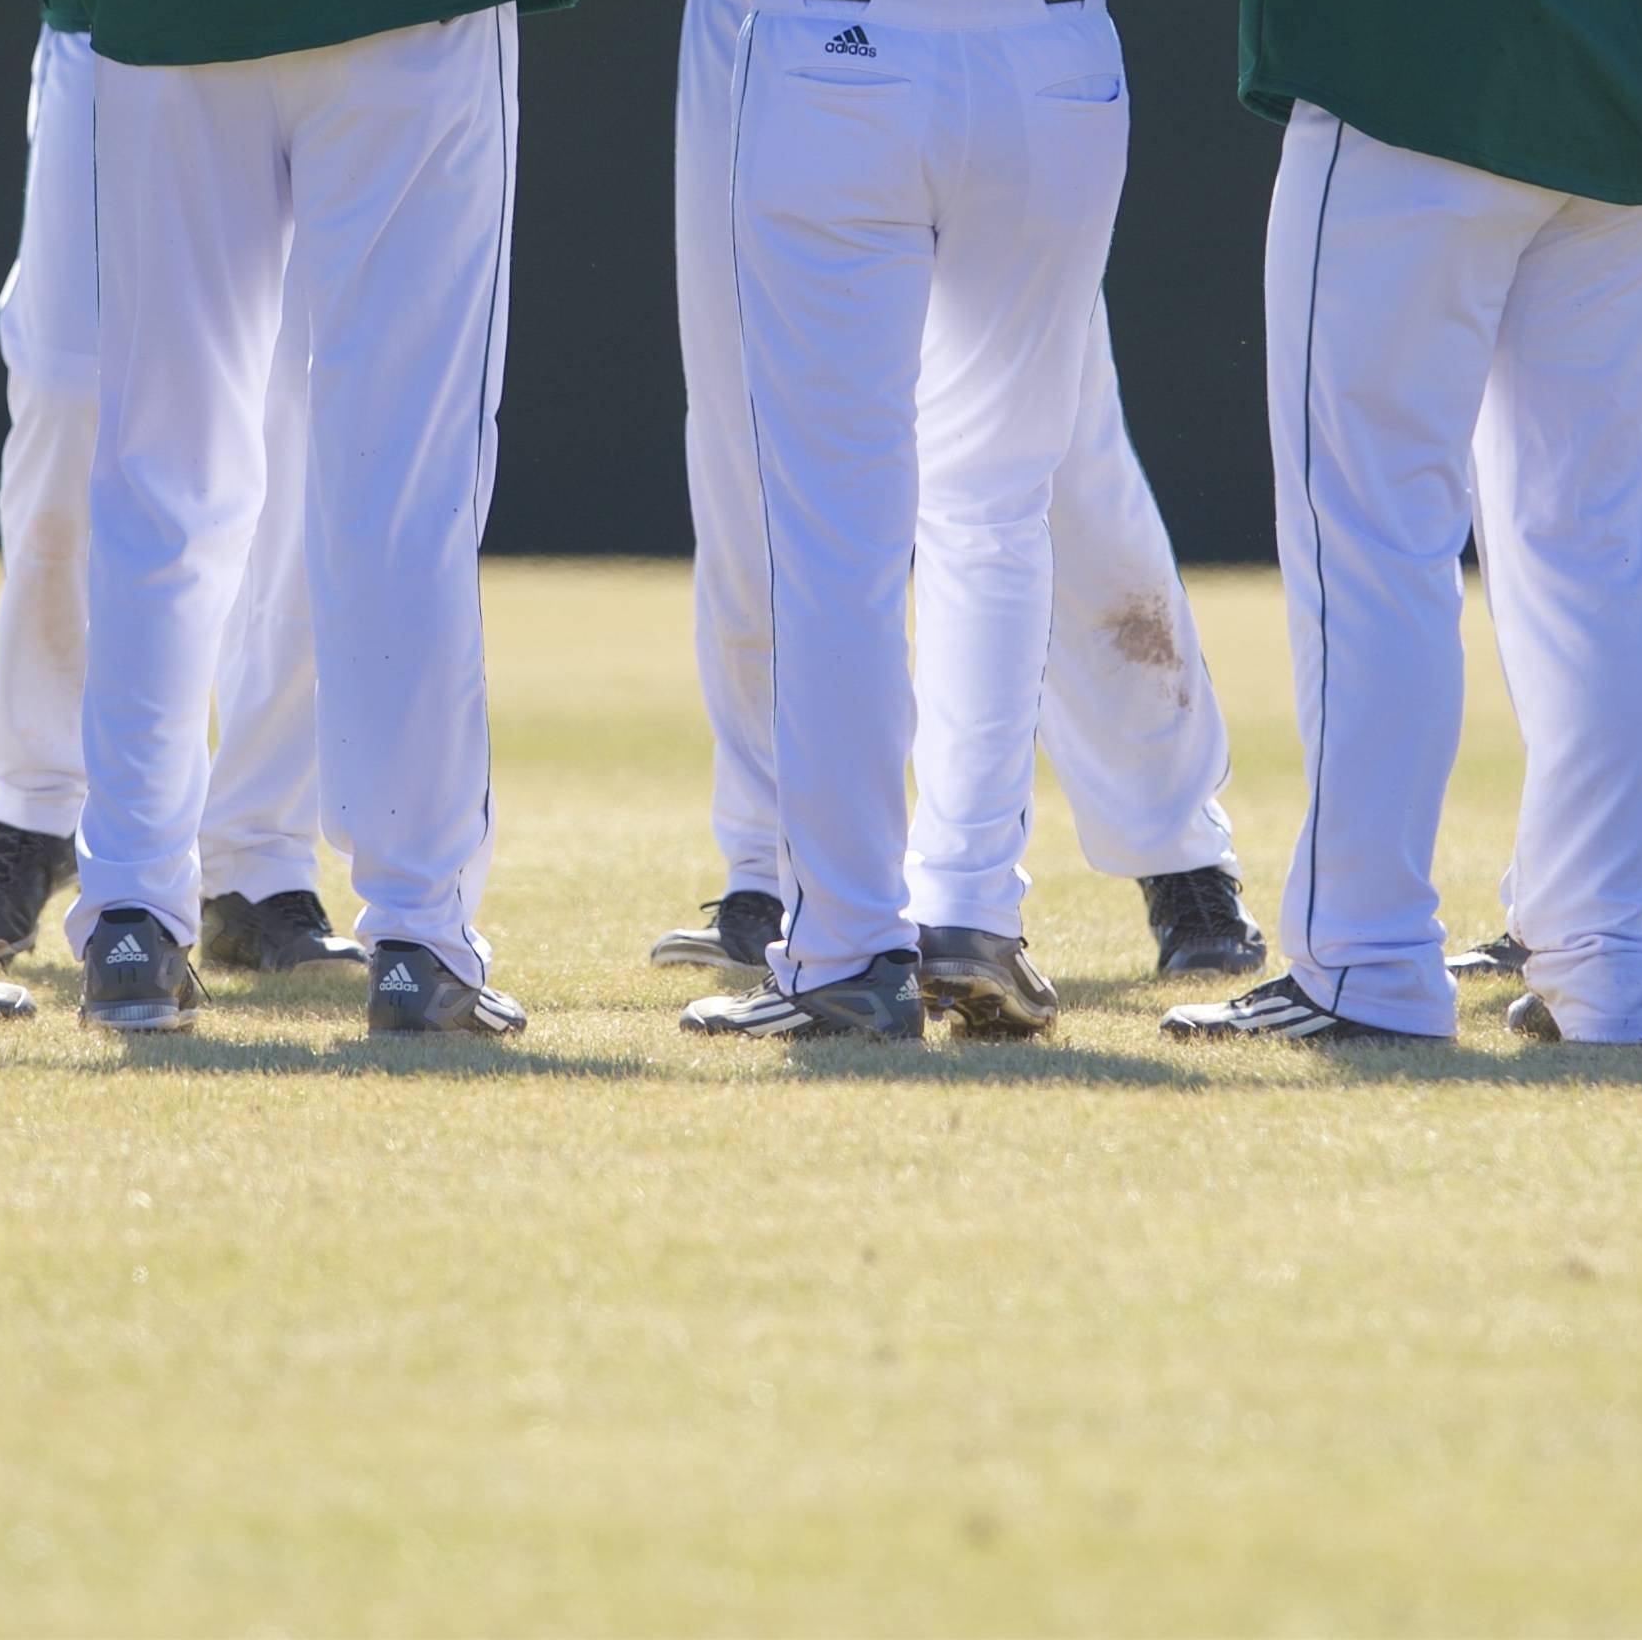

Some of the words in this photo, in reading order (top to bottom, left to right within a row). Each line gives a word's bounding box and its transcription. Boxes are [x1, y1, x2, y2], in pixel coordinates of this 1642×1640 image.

[825, 41, 877, 58] adidas
[106, 954, 150, 965] adidas
[380, 980, 419, 993] adidas
